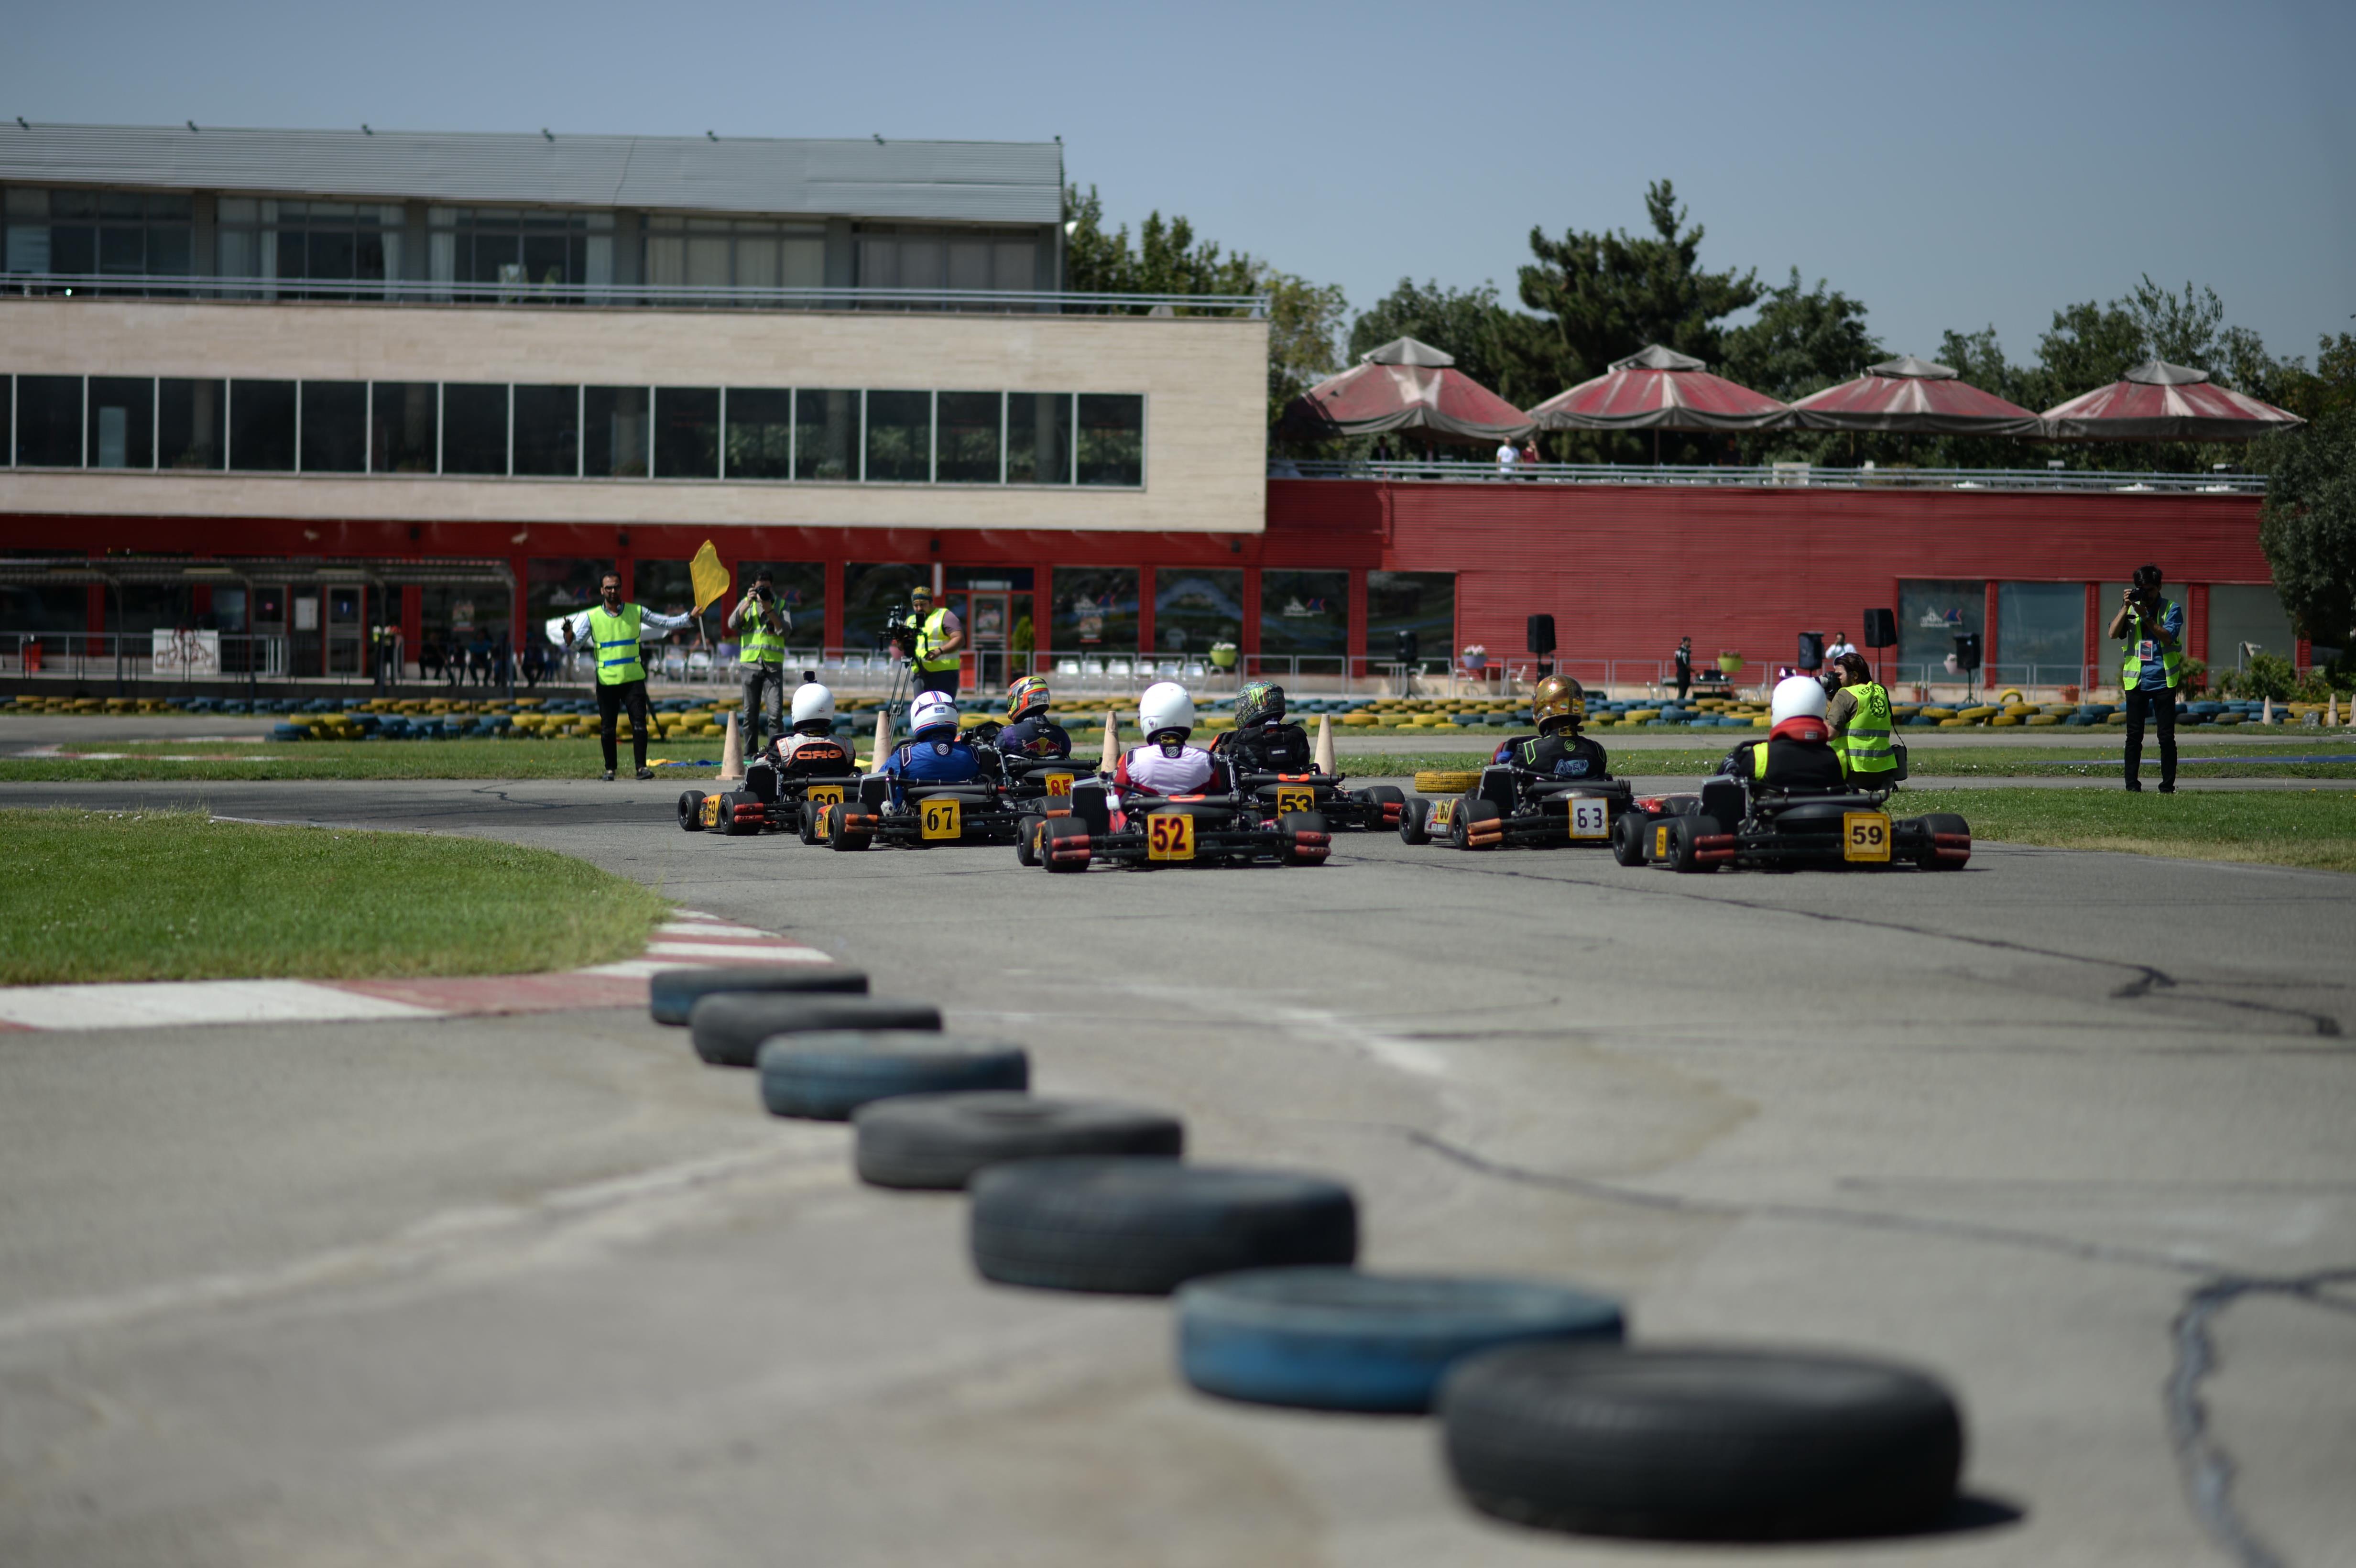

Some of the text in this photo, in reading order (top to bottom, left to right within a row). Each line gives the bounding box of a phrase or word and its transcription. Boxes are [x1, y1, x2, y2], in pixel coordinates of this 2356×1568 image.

[796, 749, 842, 760] CRG
[1050, 779, 1070, 796] 85
[708, 800, 716, 822] 69
[1280, 794, 1313, 814] 53
[1440, 799, 1452, 820] 63
[926, 806, 954, 832] 67
[1577, 808, 1603, 829] 63
[1152, 816, 1187, 852] 52
[1852, 825, 1883, 845] 59
